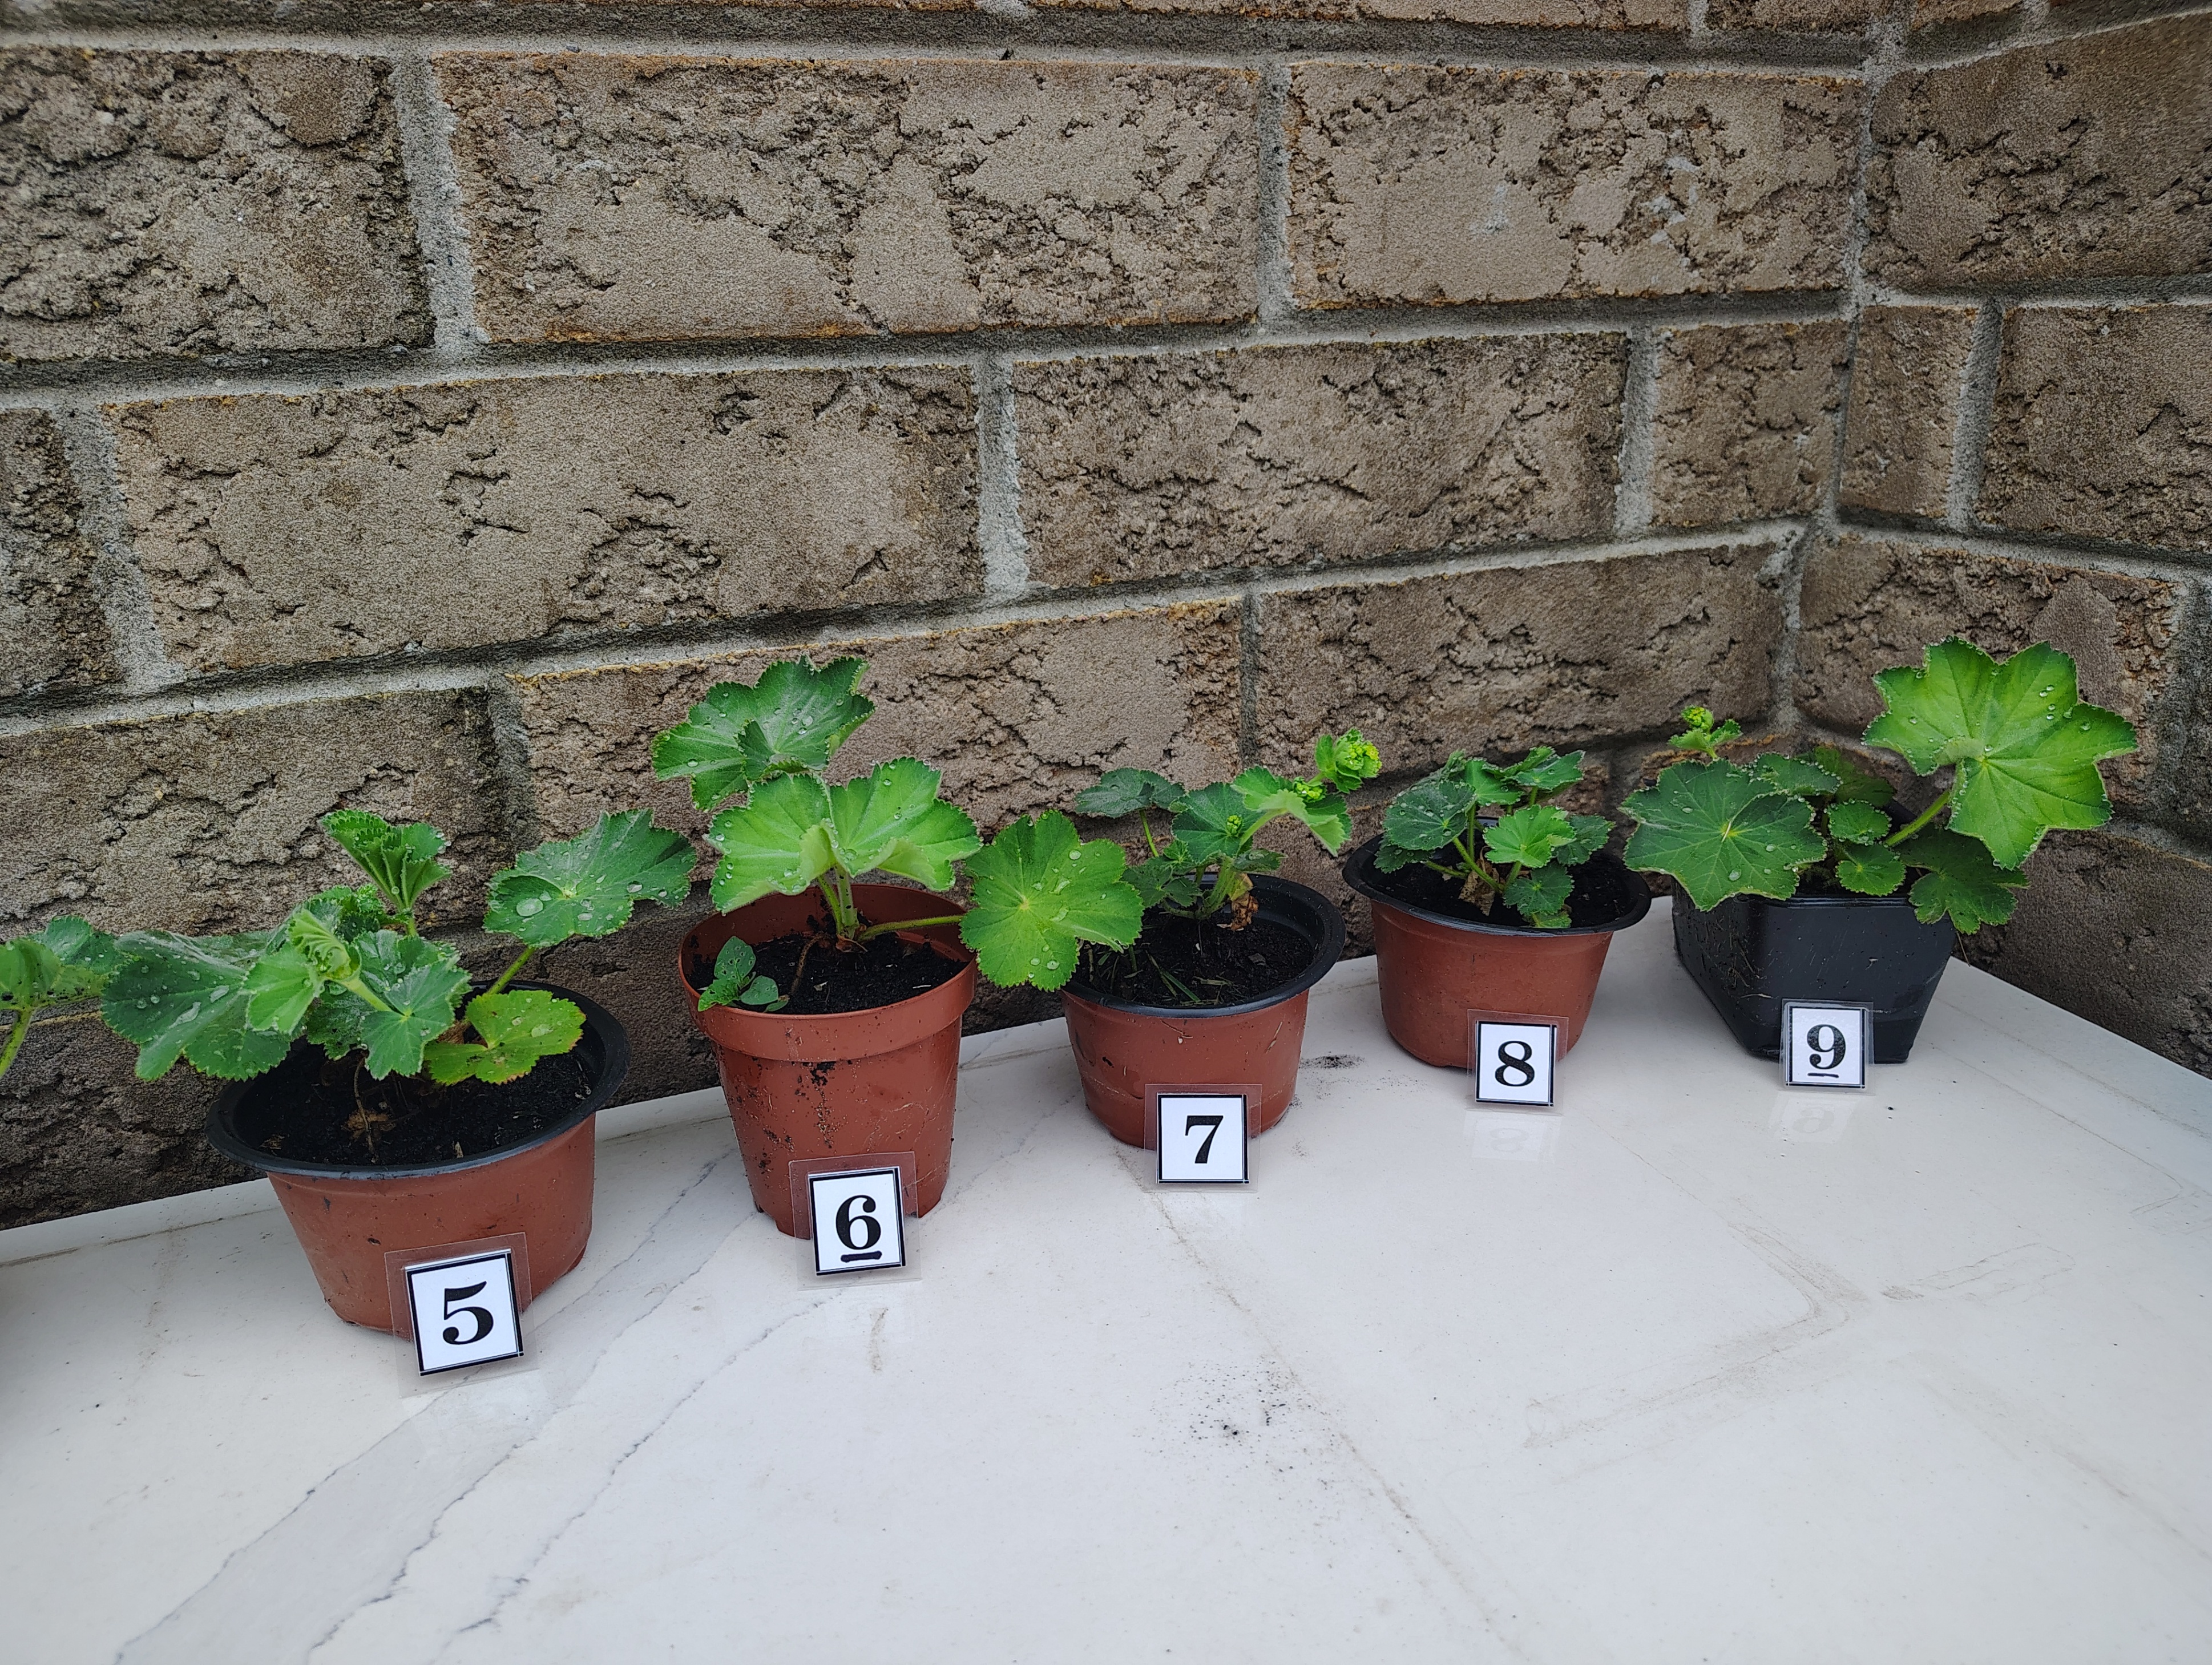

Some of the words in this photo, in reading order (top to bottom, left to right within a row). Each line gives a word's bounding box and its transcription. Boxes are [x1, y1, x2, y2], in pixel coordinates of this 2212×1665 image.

[1494, 1040, 1535, 1087] 8
[1806, 1024, 1846, 1070] 9
[1184, 1115, 1224, 1164] 7
[835, 1194, 882, 1250] 6
[442, 1280, 494, 1345] 5
